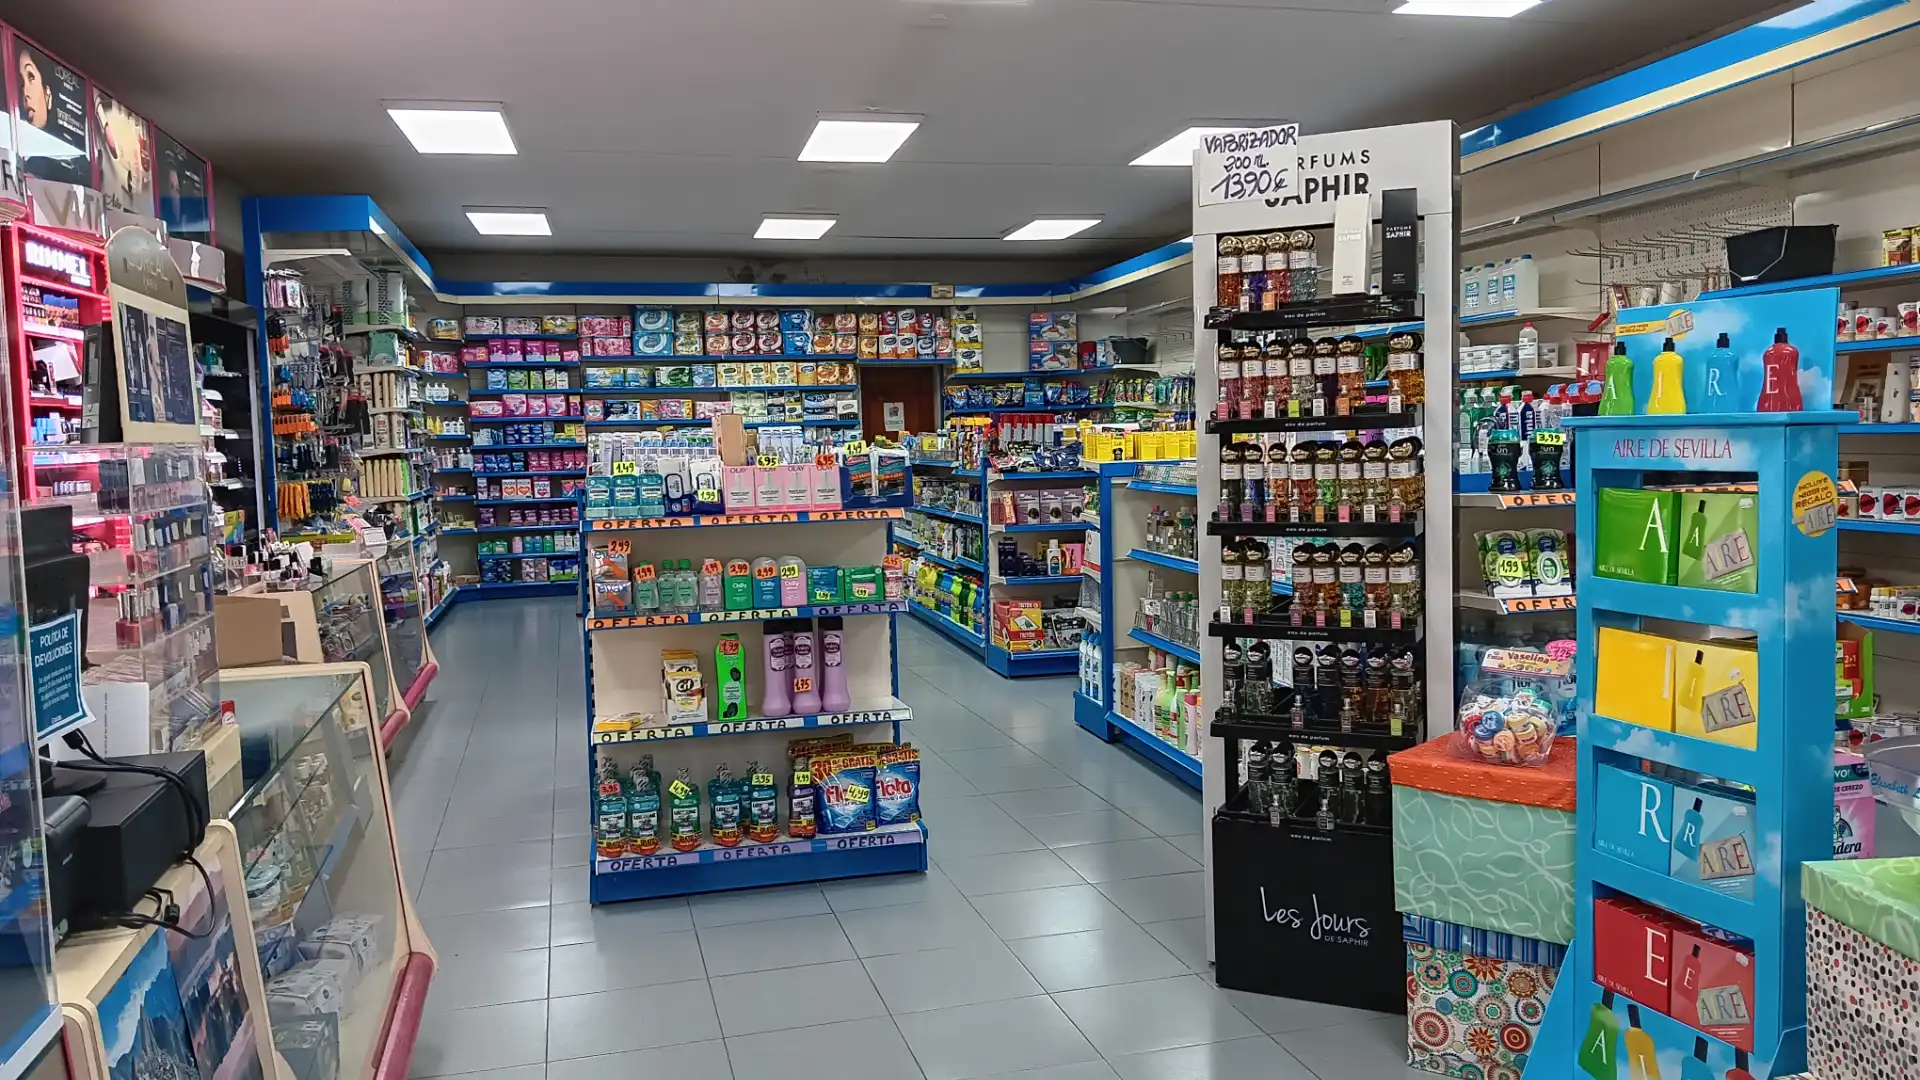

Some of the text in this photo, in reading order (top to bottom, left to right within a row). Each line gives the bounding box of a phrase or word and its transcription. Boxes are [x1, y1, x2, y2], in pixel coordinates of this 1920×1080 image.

[1204, 125, 1297, 155] VAPORIZADOR
[1223, 155, 1253, 173] 200
[1297, 149, 1371, 171] RFUMS
[1386, 231, 1412, 239] SAPHIR
[1604, 375, 1619, 400] A
[1708, 368, 1726, 397] R
[1765, 364, 1780, 394] E
[1538, 433, 1561, 443] 3,99
[1612, 438, 1733, 459] AIRE DE SEVILLA
[1513, 494, 1576, 506] OFER
[1795, 491, 1833, 510] REGALO
[711, 514, 792, 525] OFERTA
[819, 510, 890, 521] OFERTA
[602, 518, 682, 530] OFERTA
[1638, 497, 1669, 553] A
[1689, 526, 1700, 547] A
[818, 602, 900, 616] OFERTA
[1516, 597, 1575, 611] OFER
[593, 615, 685, 629] OFERTA
[709, 609, 792, 623] OFERTA
[34, 641, 73, 668] DEVOLUCIONES
[1507, 652, 1550, 665] Vaselina
[677, 679, 693, 691] Cif
[830, 711, 893, 725] OFERTA
[720, 720, 788, 733] OFERTA
[601, 728, 686, 743] OFERTA
[842, 755, 876, 769] GRATIS
[885, 749, 919, 764] GRATIS
[1834, 769, 1850, 779] VO!
[1840, 784, 1864, 792] CEREZO
[1637, 782, 1670, 844] R
[837, 834, 895, 849] OFERTA
[1683, 822, 1697, 848] R
[723, 844, 792, 859] OFERTA
[610, 856, 678, 872] OFERTA
[1260, 886, 1372, 940] Les Jours
[1324, 935, 1369, 947] DE SAPHIR
[1644, 926, 1668, 987] E
[1683, 967, 1696, 990] E
[1590, 1029, 1607, 1065] A
